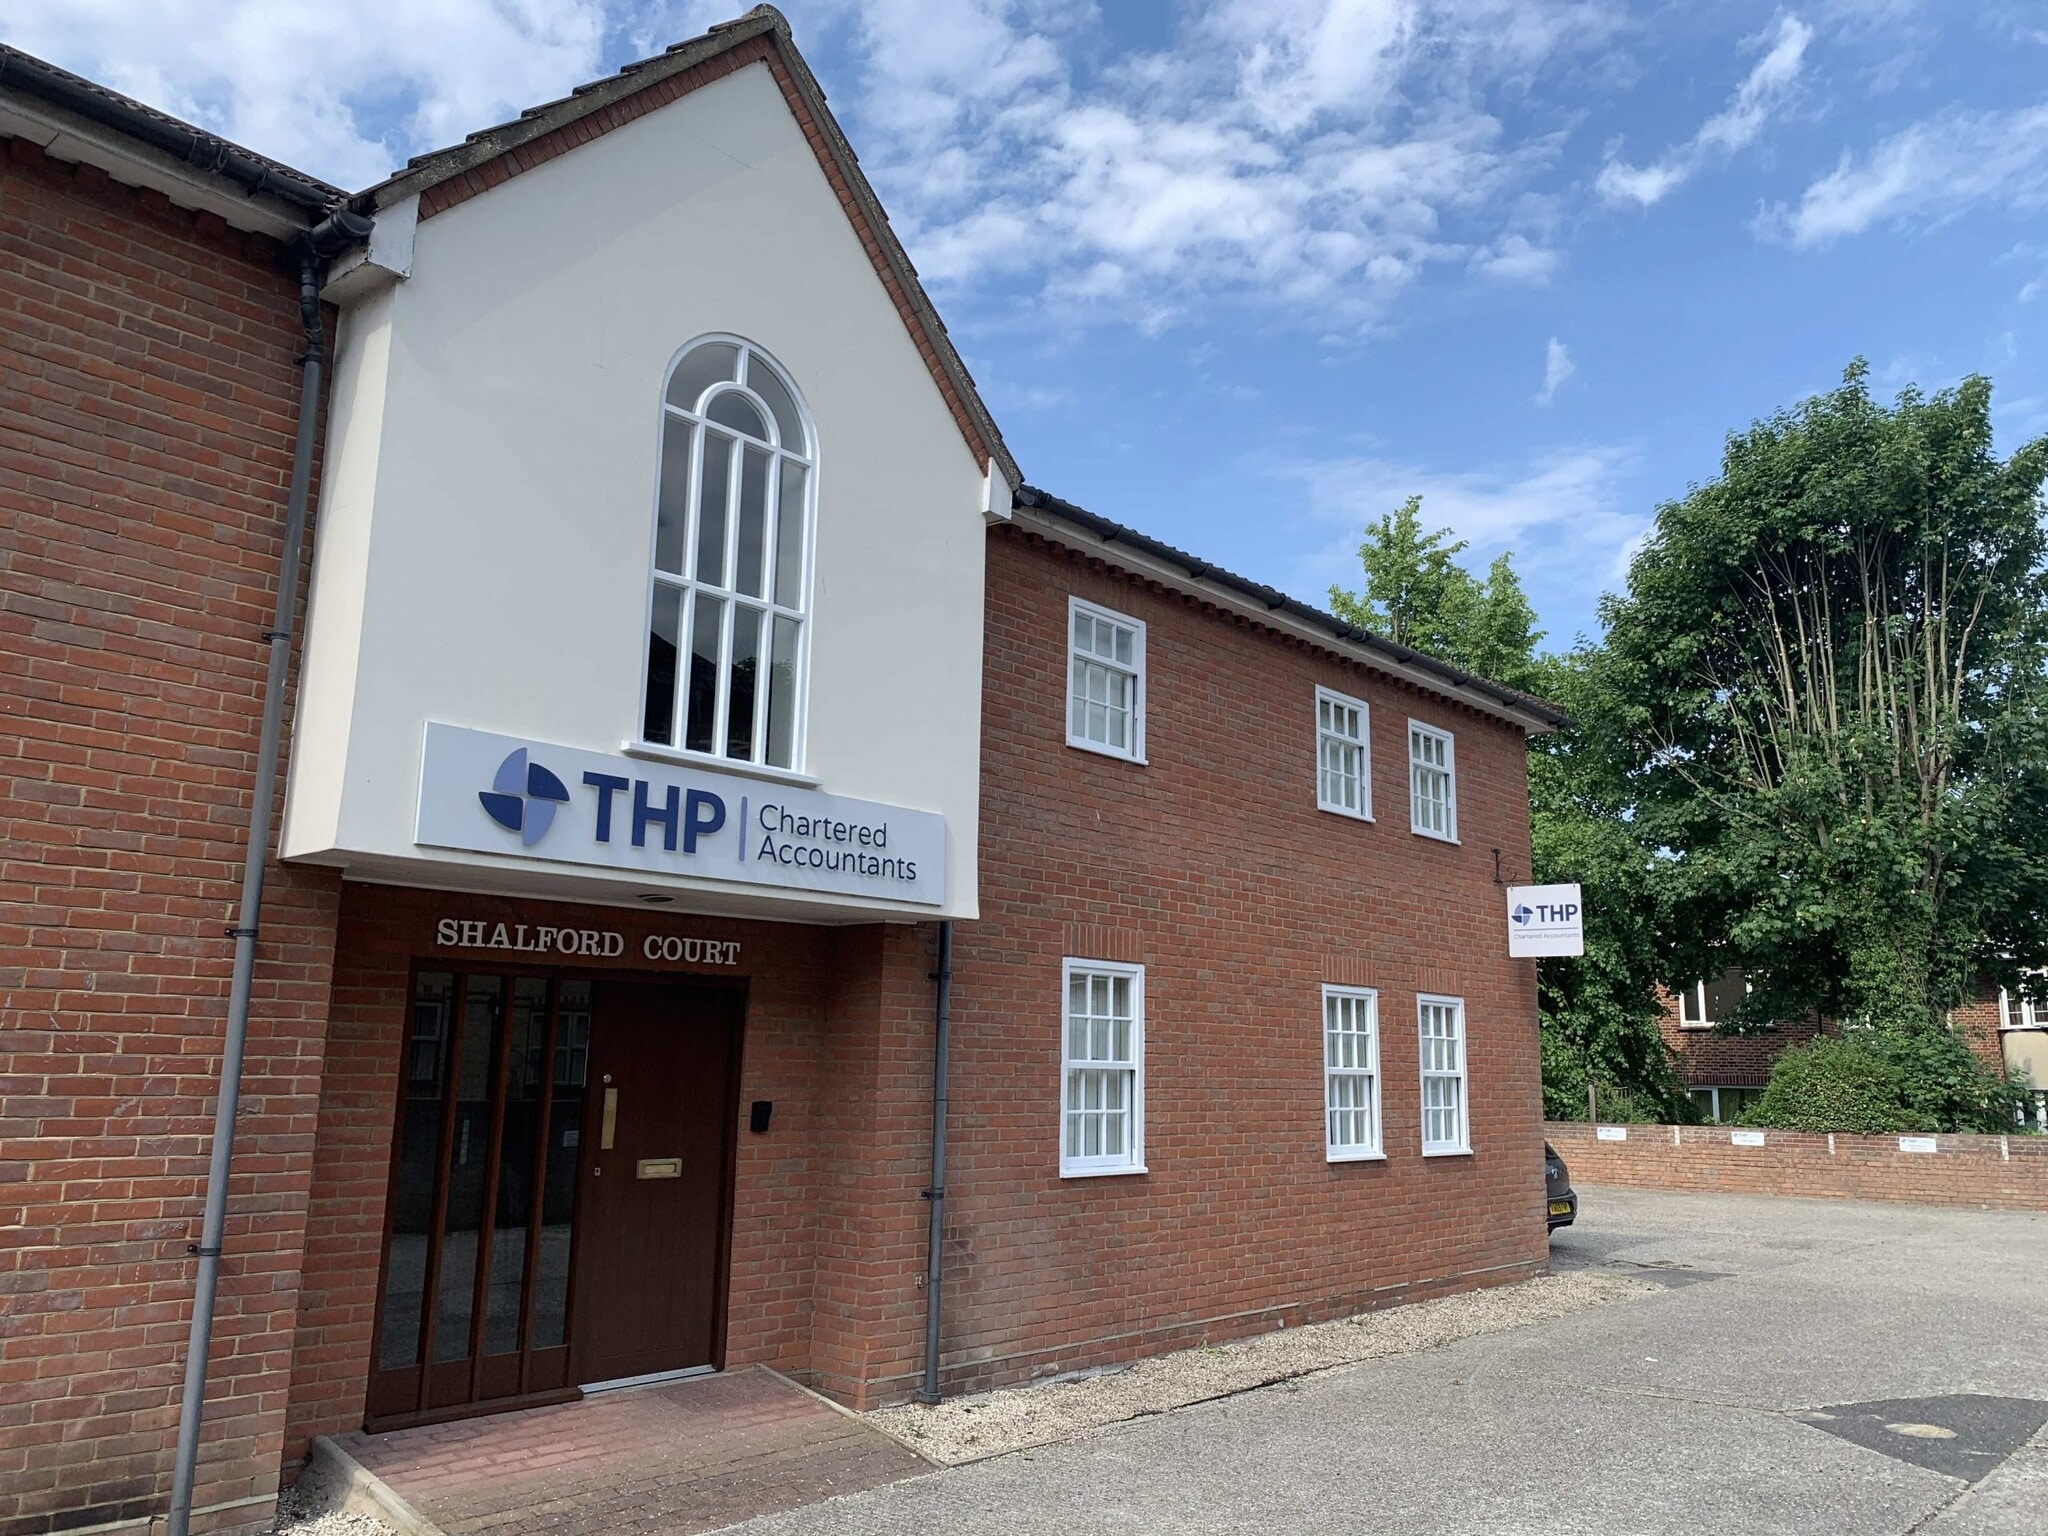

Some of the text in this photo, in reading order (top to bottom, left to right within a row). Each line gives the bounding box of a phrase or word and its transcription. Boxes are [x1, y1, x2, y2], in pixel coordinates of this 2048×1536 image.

[582, 770, 726, 855] THP
[759, 804, 887, 849] Chartered
[757, 834, 917, 881] Accountants
[1513, 932, 1542, 940] Chartered
[1536, 904, 1578, 922] THP
[436, 917, 741, 966] SHALFORD COURT
